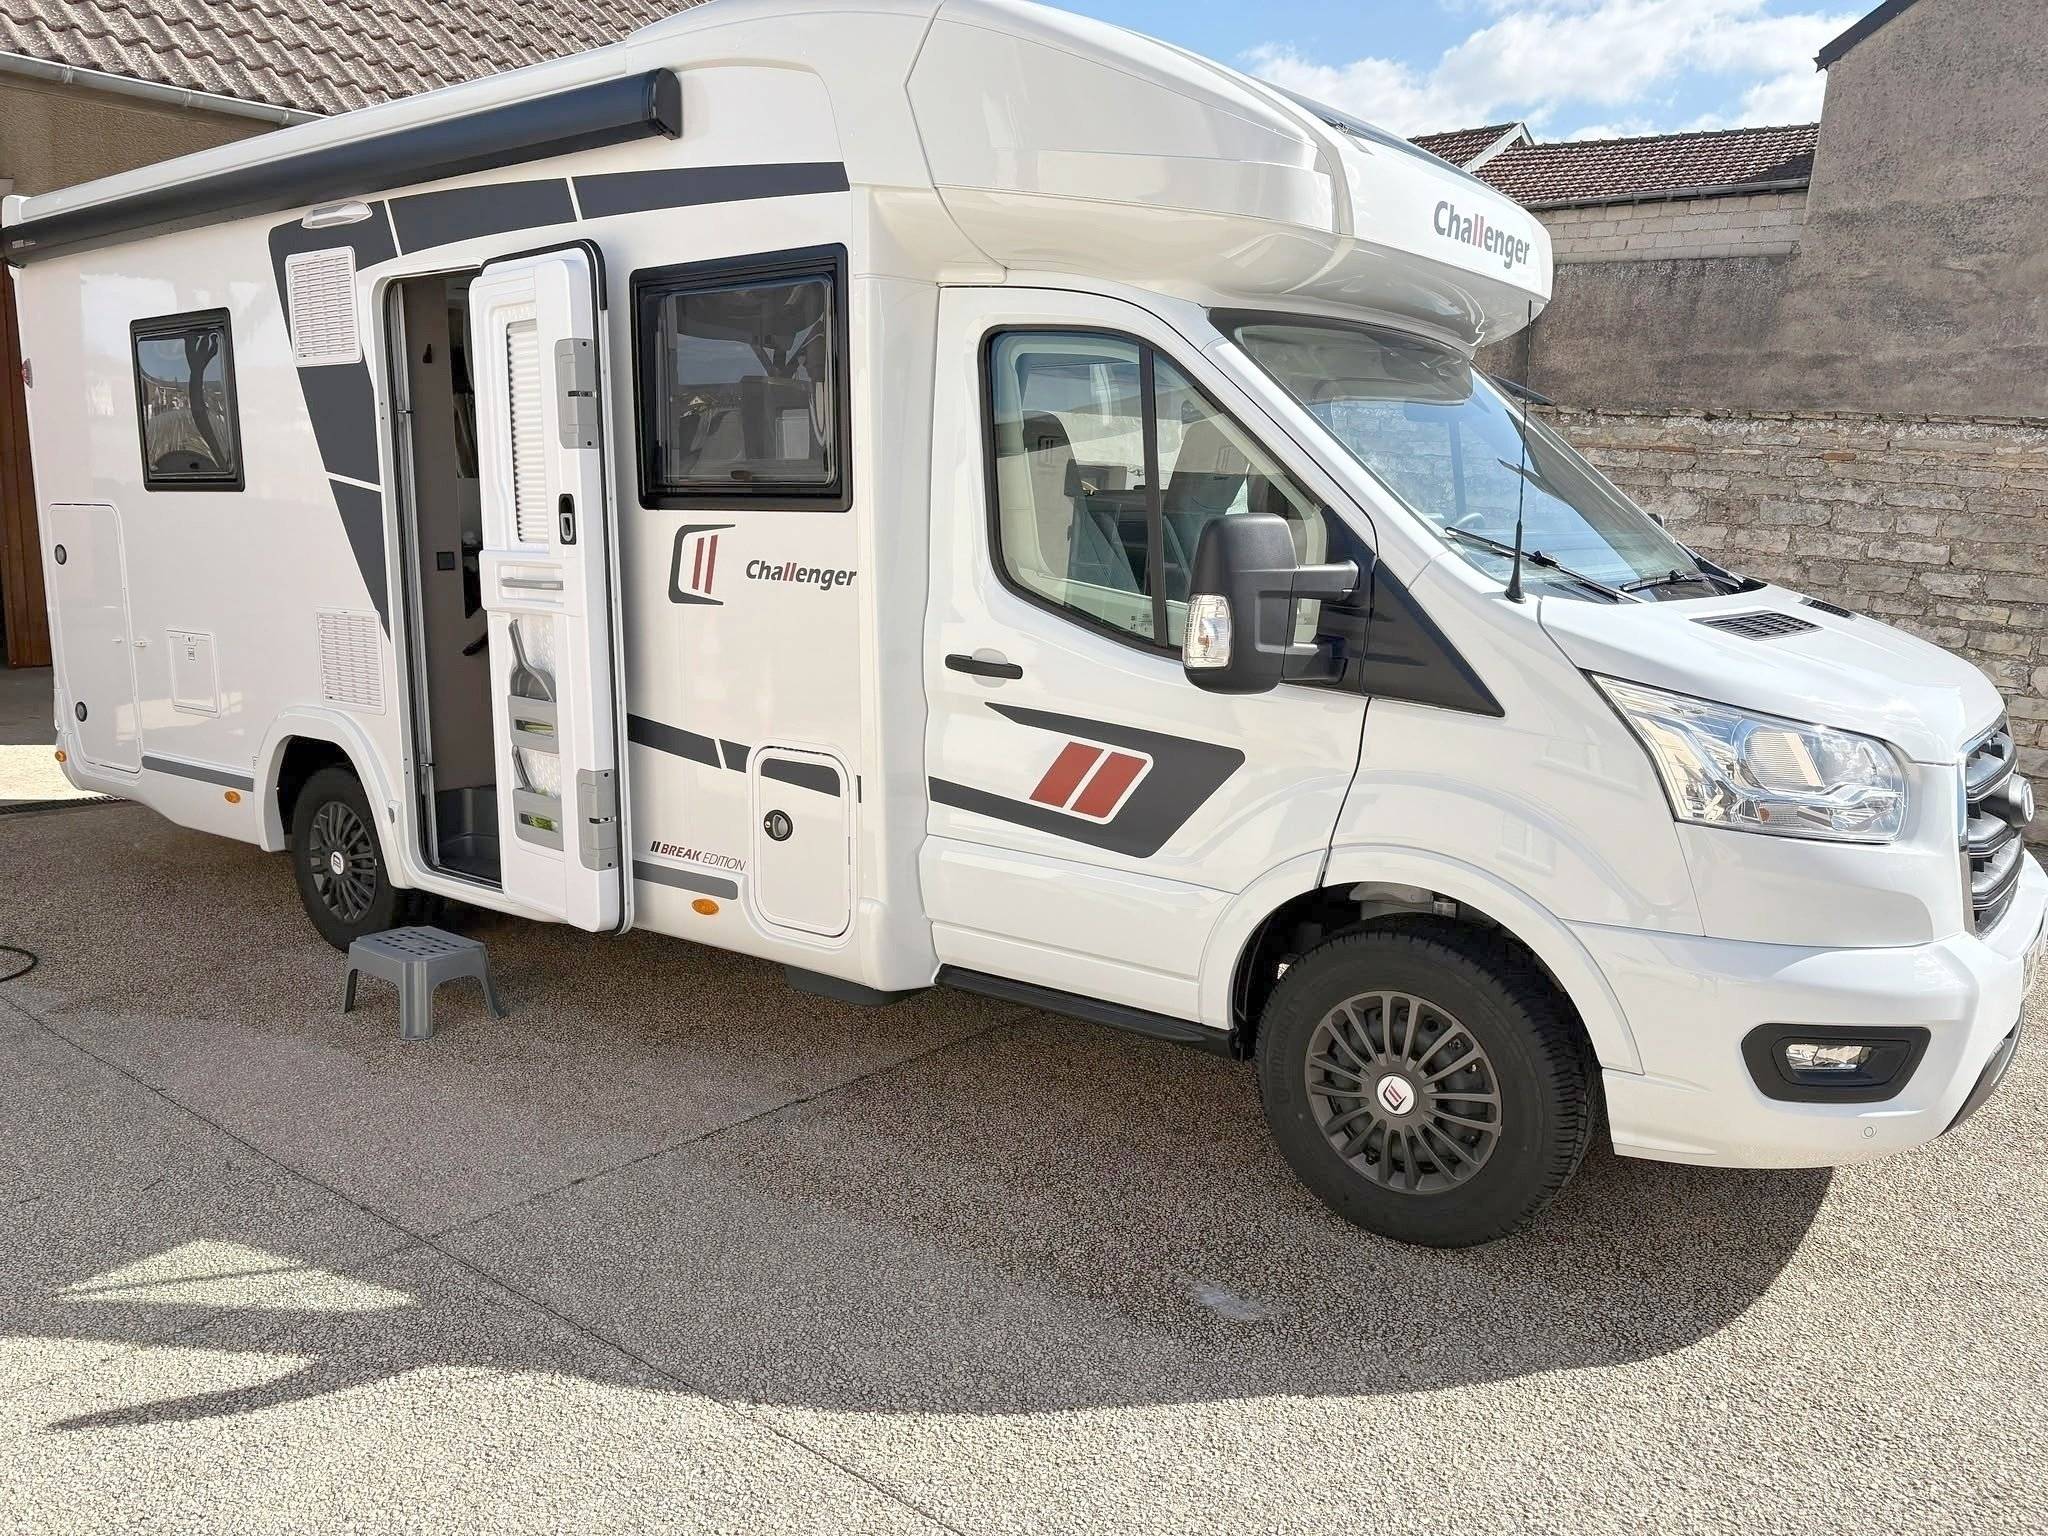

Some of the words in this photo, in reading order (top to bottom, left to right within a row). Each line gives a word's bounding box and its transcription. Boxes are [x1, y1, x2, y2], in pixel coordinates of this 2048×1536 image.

[1434, 201, 1530, 269] Challenger
[746, 560, 857, 590] Challenger
[660, 843, 702, 861] BREAK
[702, 852, 746, 871] EDITION
